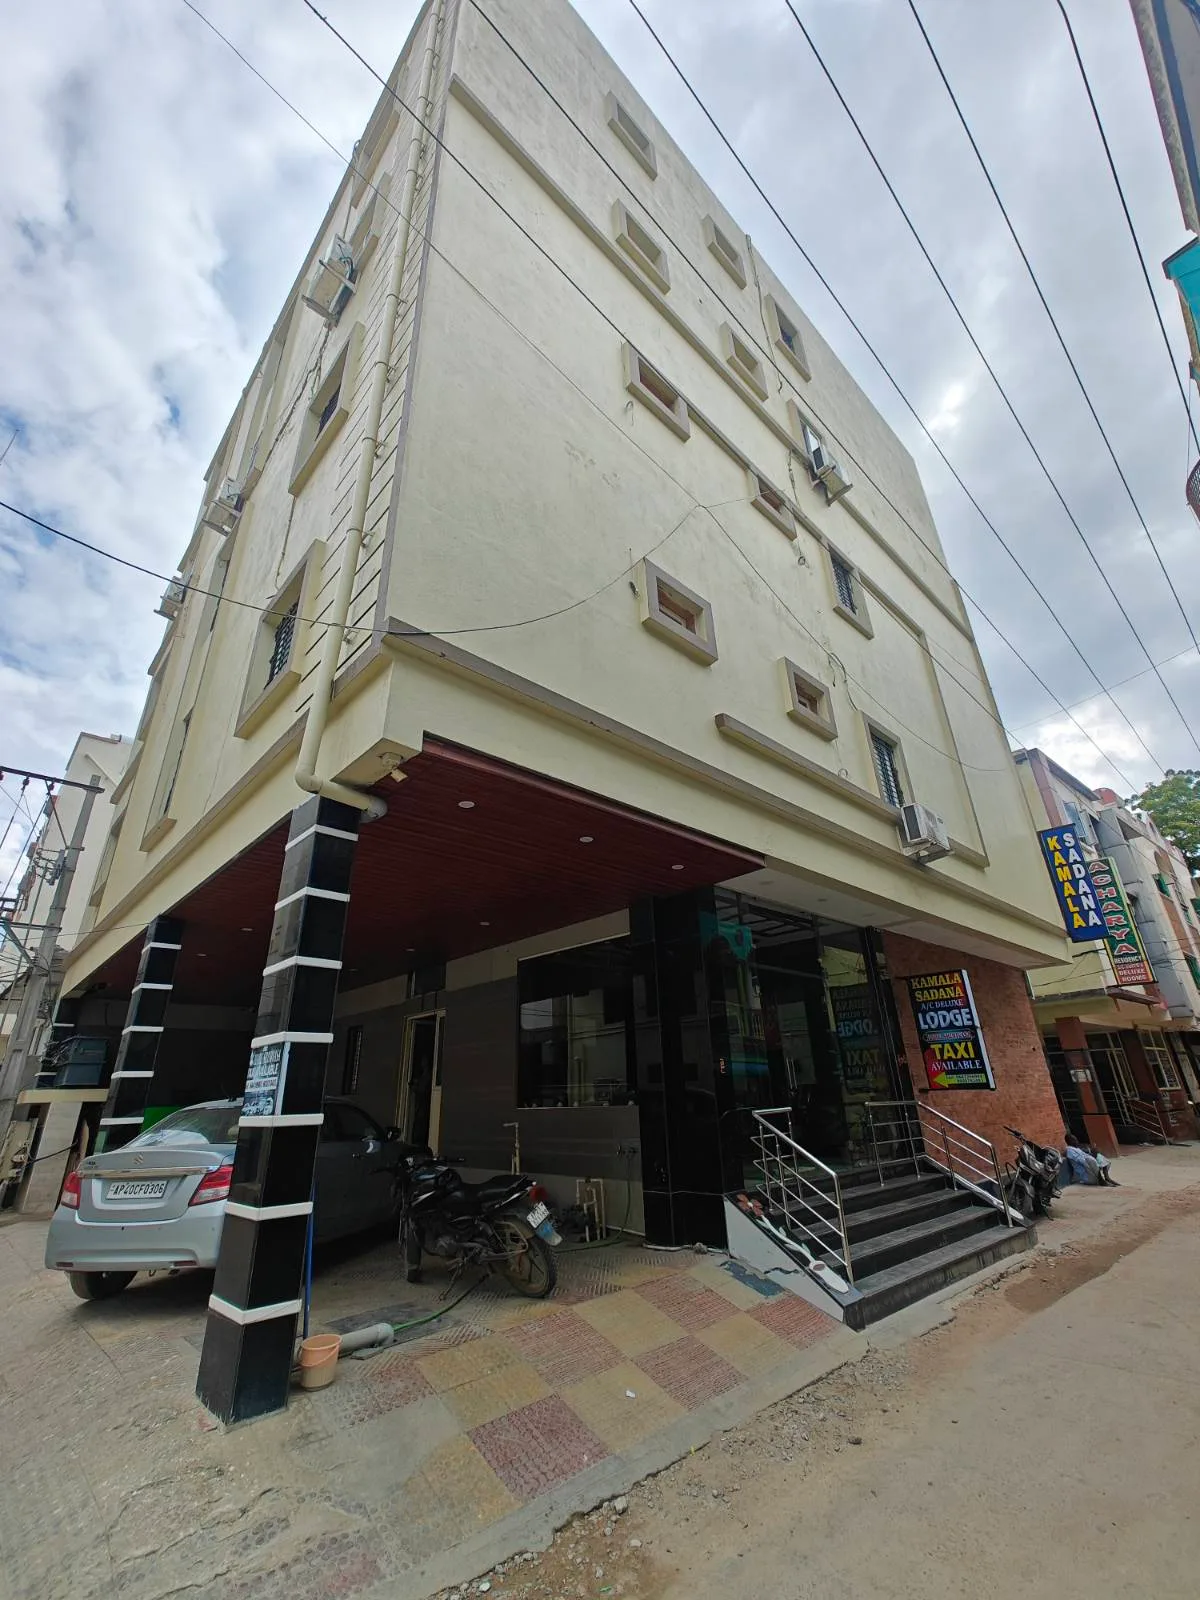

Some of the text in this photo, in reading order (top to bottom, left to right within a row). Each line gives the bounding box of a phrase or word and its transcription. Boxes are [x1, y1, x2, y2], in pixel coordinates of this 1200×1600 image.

[1047, 836, 1087, 929] KAMALA
[1063, 833, 1102, 927] SADANA
[1089, 861, 1138, 956] ACHARYA
[911, 972, 962, 989] KAMALA
[915, 986, 964, 1002] SADANA
[921, 999, 964, 1010] A/C DELUXE
[918, 1008, 973, 1029] LODGE
[930, 1041, 976, 1060] TAXI
[931, 1060, 982, 1072] AVAILABLE
[113, 1182, 164, 1195] AP40CF0306
